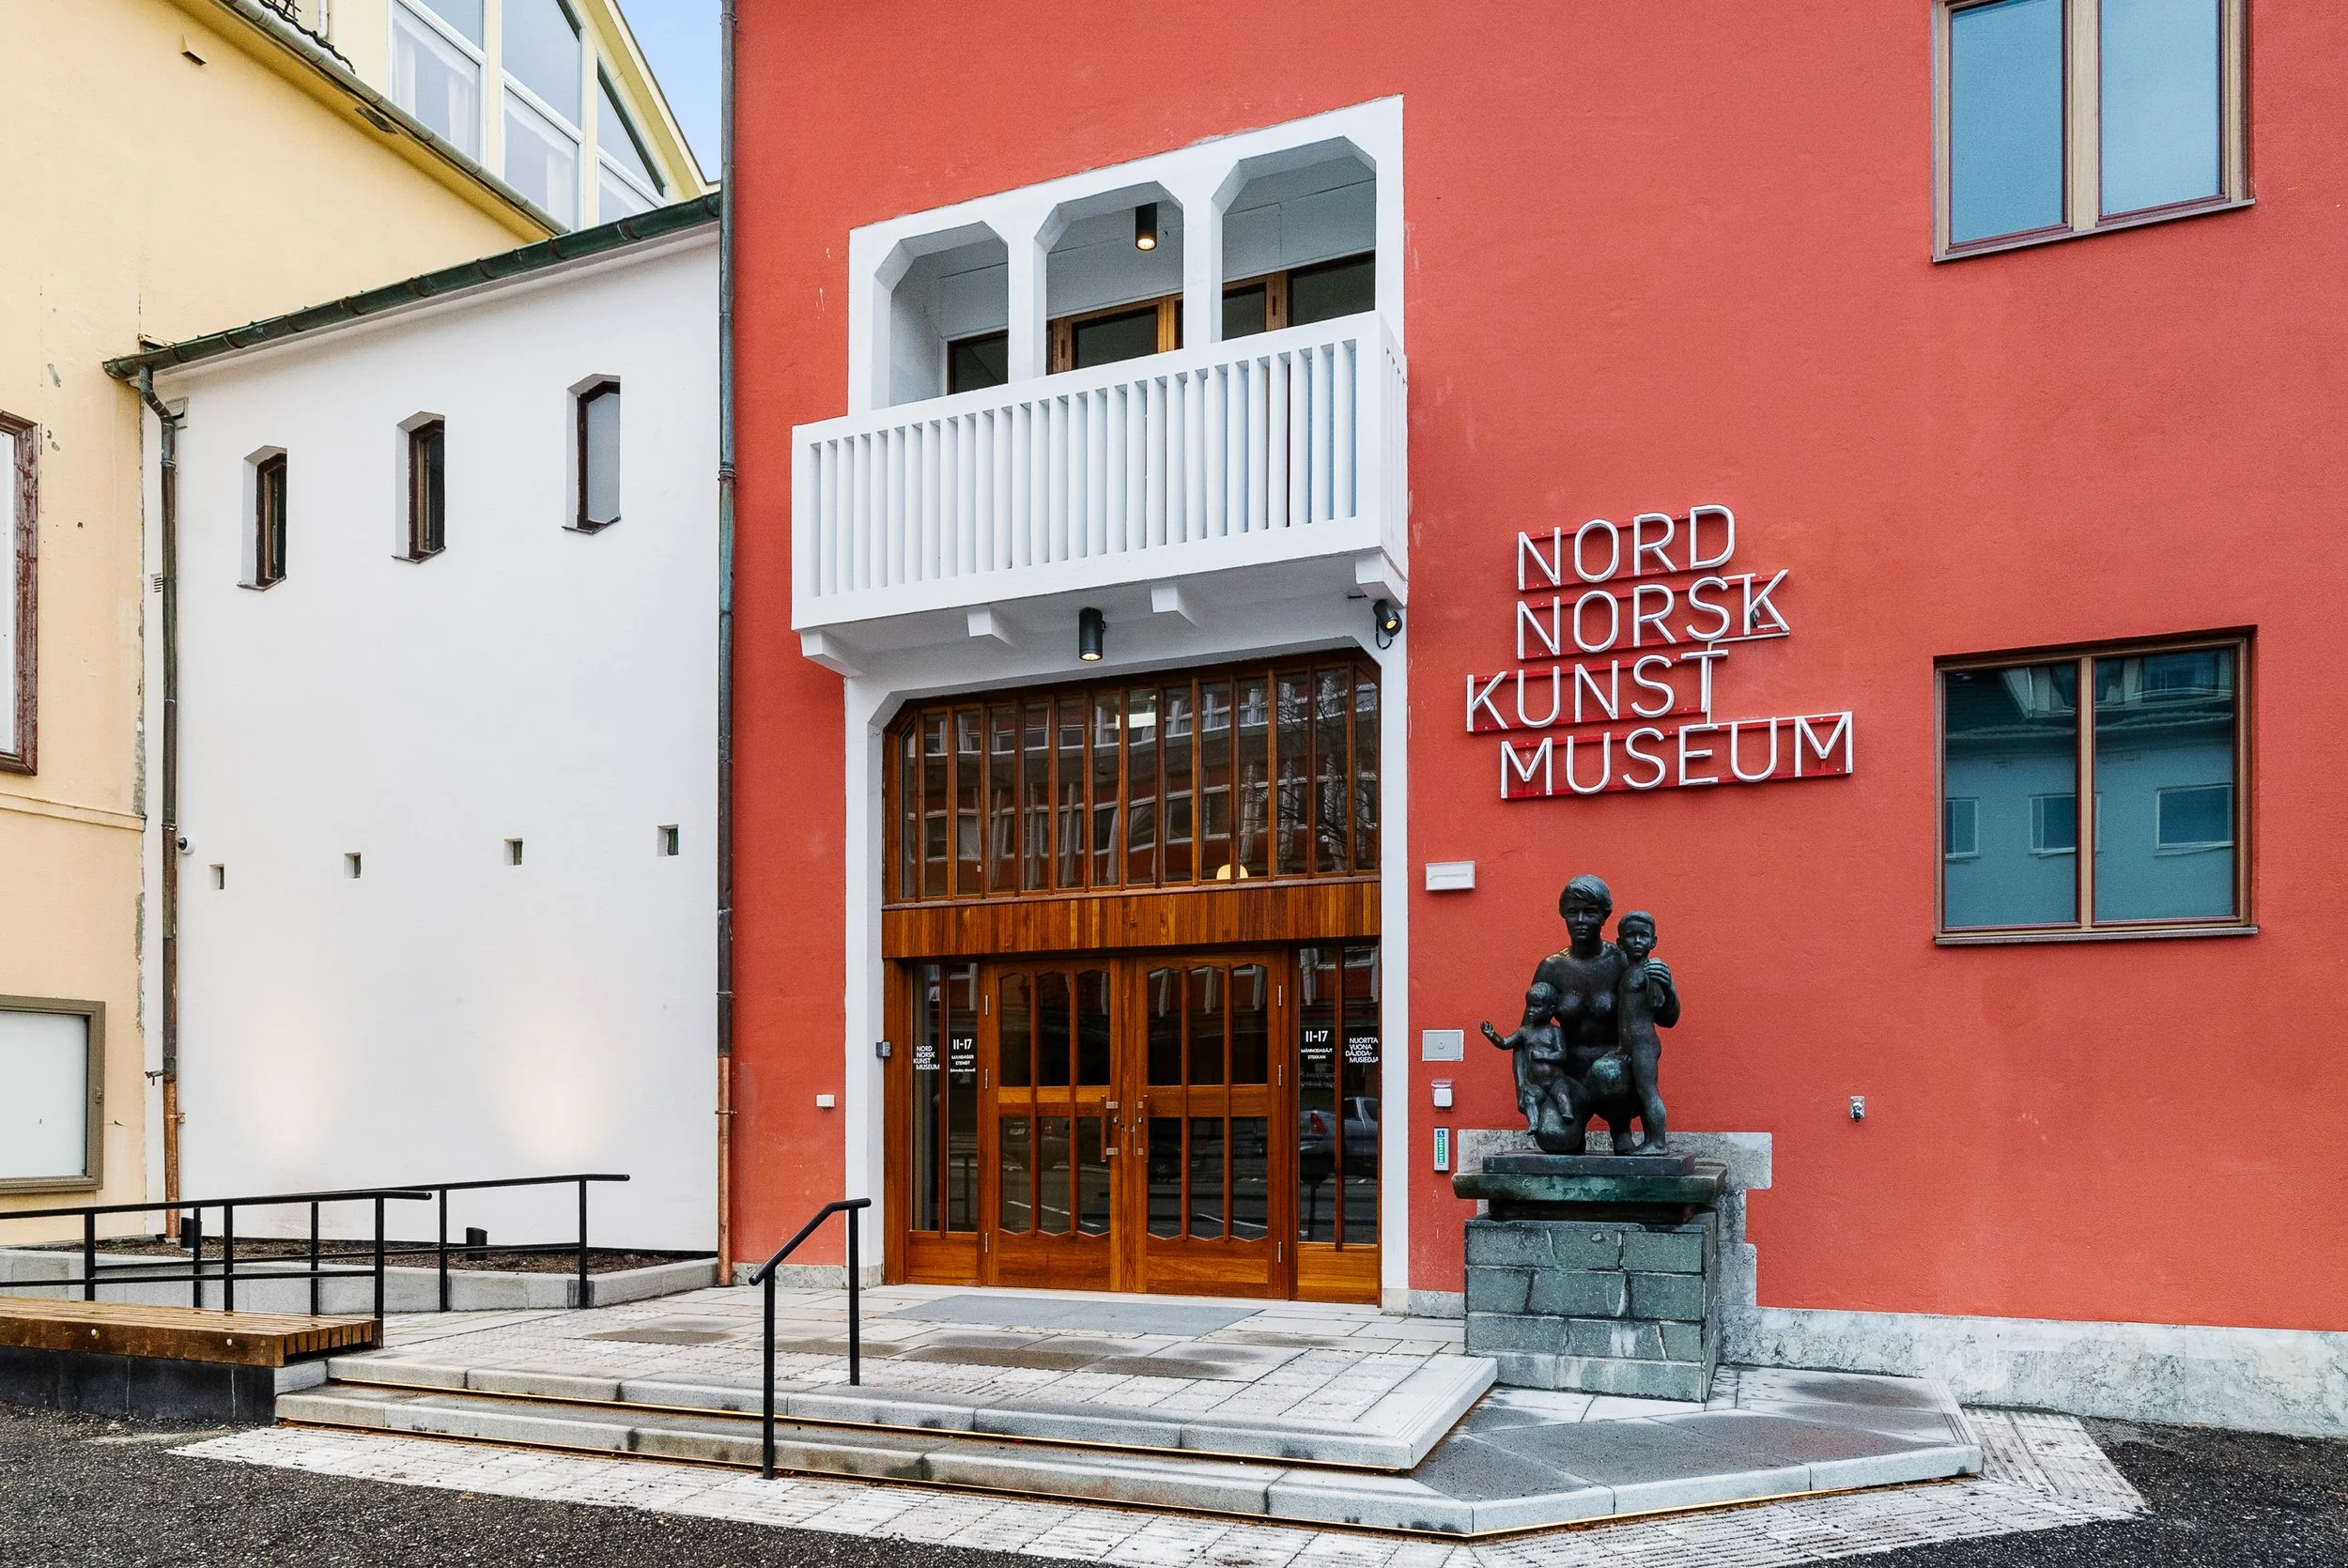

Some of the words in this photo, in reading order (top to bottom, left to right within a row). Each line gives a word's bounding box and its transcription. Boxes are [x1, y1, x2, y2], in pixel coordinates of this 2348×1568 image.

[1518, 504, 1736, 591] NORD
[1517, 569, 1789, 659] NORSK
[1467, 649, 1728, 731] KUNST
[1500, 711, 1853, 798] MUSEUM
[953, 1038, 972, 1050] 11-17
[1305, 1030, 1328, 1042] 11-17
